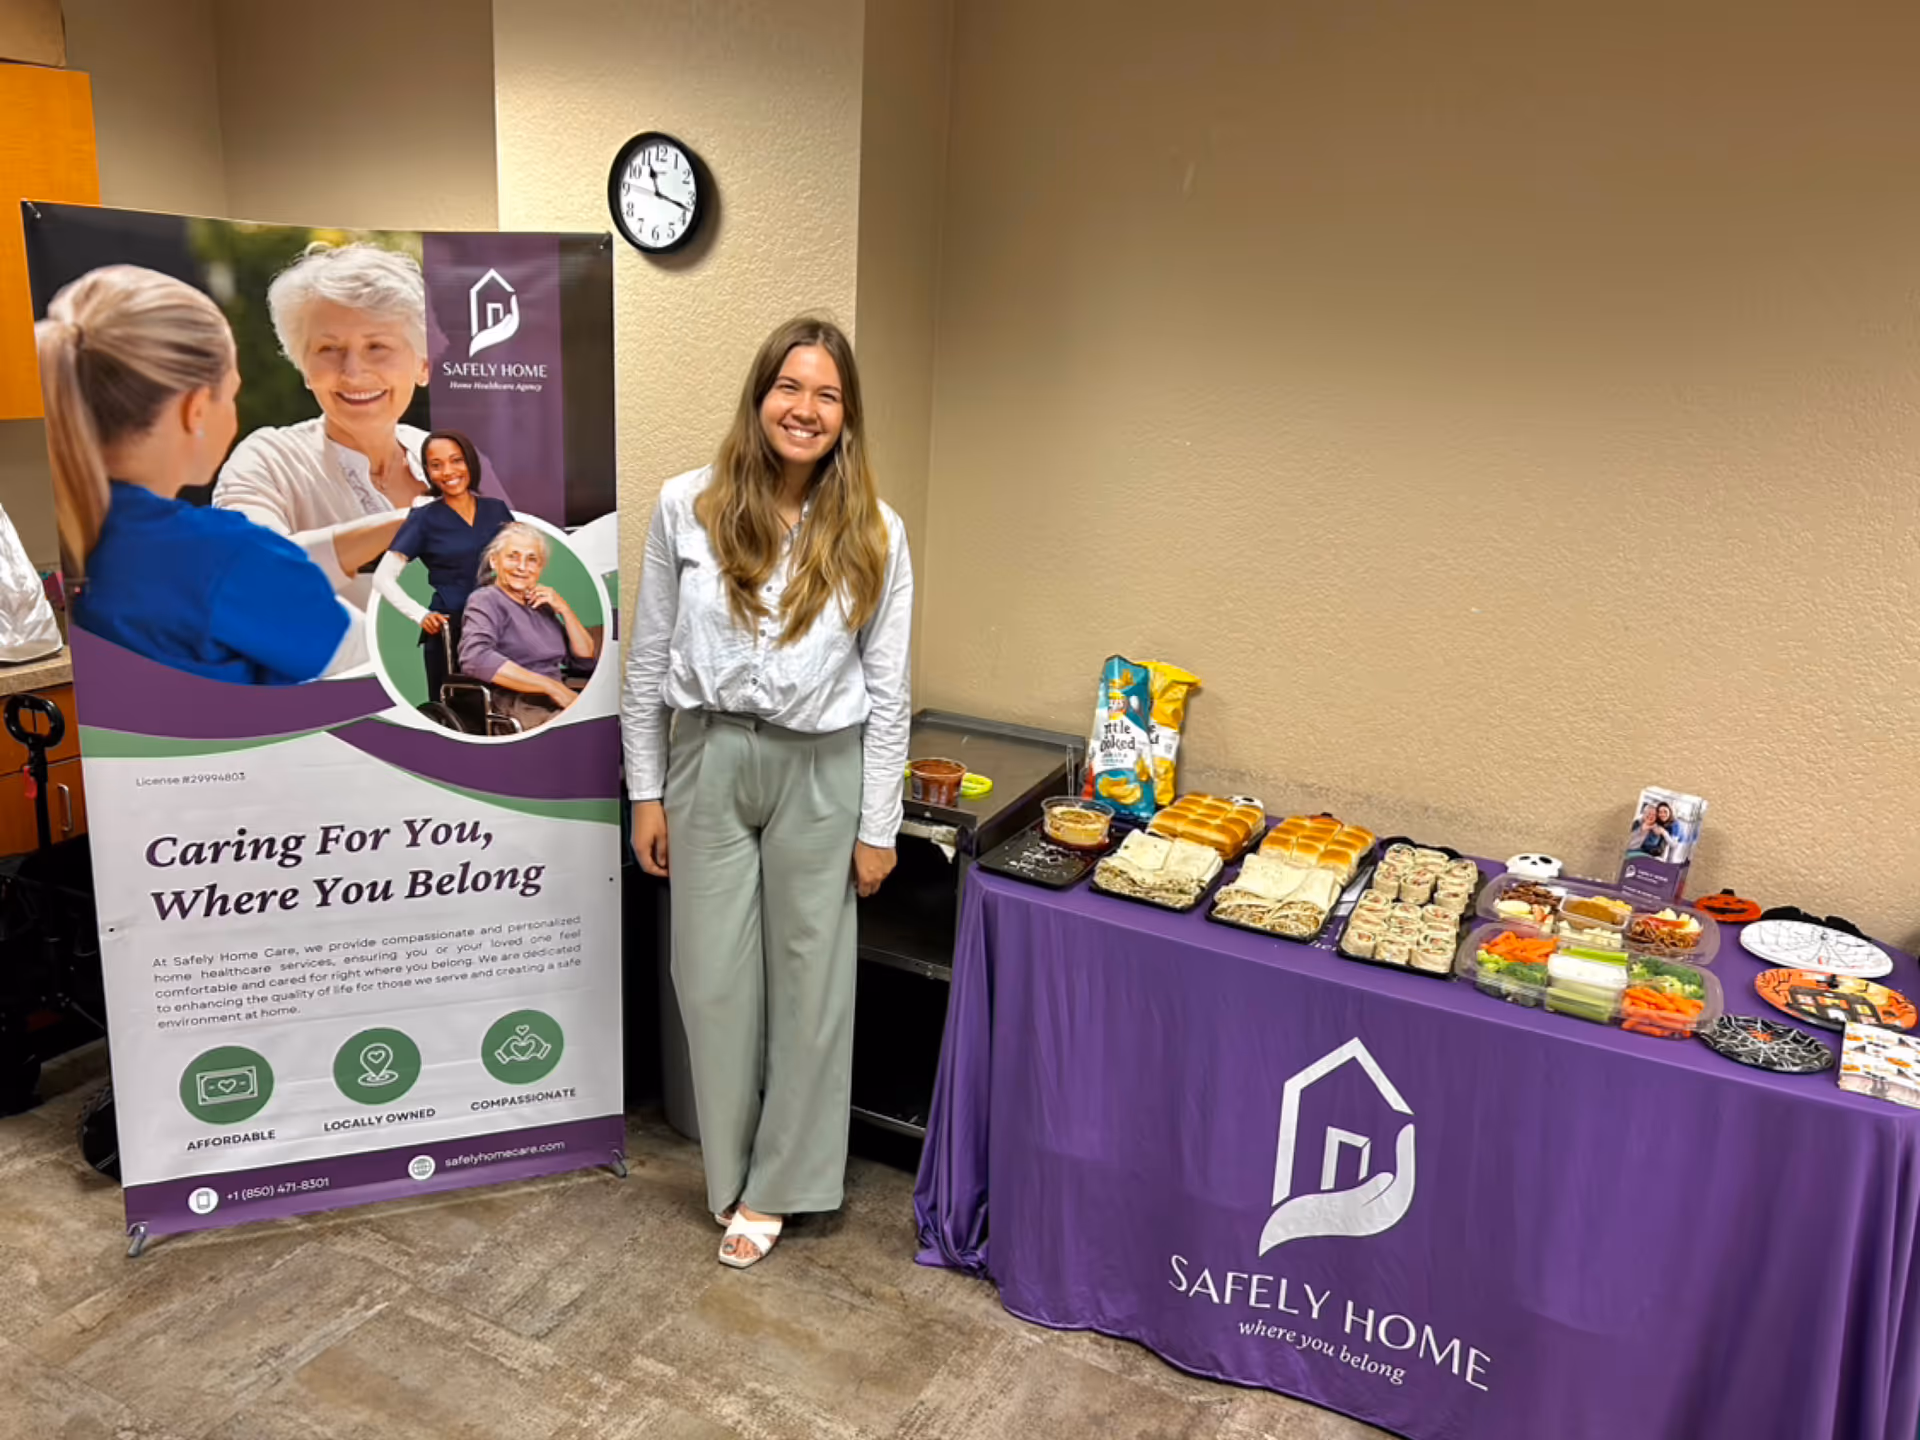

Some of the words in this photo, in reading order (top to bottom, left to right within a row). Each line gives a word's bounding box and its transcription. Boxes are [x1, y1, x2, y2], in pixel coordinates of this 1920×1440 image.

[642, 149, 651, 166] 11
[656, 145, 668, 162] 12
[674, 153, 679, 169] 1
[629, 160, 642, 179] 10
[682, 169, 691, 185] 2
[622, 182, 631, 196] 9
[687, 191, 696, 207] 3
[626, 202, 634, 217] 8
[638, 217, 645, 234] 7
[652, 225, 660, 241] 6
[667, 222, 675, 239] 5
[443, 361, 497, 377] SAFELY
[501, 363, 547, 378] HOME
[450, 381, 472, 390] Home
[473, 382, 514, 391] Healthcare
[515, 383, 542, 393] Agency
[136, 776, 180, 787] License
[144, 826, 306, 868] Caring
[316, 824, 391, 856] For
[402, 817, 495, 850] You,
[150, 882, 300, 921] Where
[312, 874, 394, 908] You
[403, 861, 546, 899] Belong
[152, 958, 167, 968] At
[173, 953, 214, 967] Safely
[220, 950, 259, 962] Home
[263, 946, 300, 958] Care,
[303, 944, 323, 953] we
[328, 937, 377, 952] provide
[381, 927, 476, 946] compassionate
[480, 924, 503, 935] and
[507, 915, 582, 933] personalized
[153, 972, 192, 983] home
[200, 964, 272, 979] healthcare
[280, 958, 336, 972] services,
[343, 950, 398, 965] ensuring
[405, 947, 428, 959] you
[436, 945, 448, 955] or
[456, 941, 482, 954] your
[490, 936, 523, 949] loved
[530, 933, 553, 944] one
[559, 928, 582, 941] feel
[154, 982, 238, 998] comfortable
[241, 978, 266, 990] and
[268, 972, 306, 987] cared
[310, 972, 328, 982] for
[331, 968, 362, 981] right
[364, 964, 402, 978] where
[405, 962, 428, 974] you
[478, 954, 498, 964] We
[500, 950, 521, 962] are
[522, 943, 582, 960] dedicated
[156, 1004, 172, 1014] to
[174, 997, 243, 1013] enhancing
[246, 993, 268, 1005] the
[271, 987, 314, 1004] quality
[317, 986, 330, 997] of
[334, 984, 353, 995] life
[356, 981, 374, 992] for
[377, 977, 412, 990] those
[414, 974, 433, 985] we
[435, 972, 468, 984] serve
[470, 967, 494, 980] and
[496, 963, 545, 977] creating
[557, 957, 582, 969] safe
[157, 1010, 242, 1029] environment
[244, 1009, 258, 1021] at
[260, 1005, 302, 1018] home.
[470, 1087, 577, 1111] COMPASSIONATE
[324, 1114, 383, 1132] LOCALLY
[386, 1107, 436, 1123] OWNED
[187, 1129, 276, 1151] AFFORDABLE
[444, 1140, 566, 1168] safelyhomecare.com
[226, 1190, 239, 1201] +1
[241, 1184, 274, 1201] (850)
[277, 1176, 330, 1195] 471-8301
[1168, 1254, 1331, 1320] SAFELY
[1343, 1299, 1492, 1392] HOME
[1238, 1320, 1297, 1344] where
[1297, 1332, 1336, 1358] you
[1339, 1343, 1407, 1385] belong
